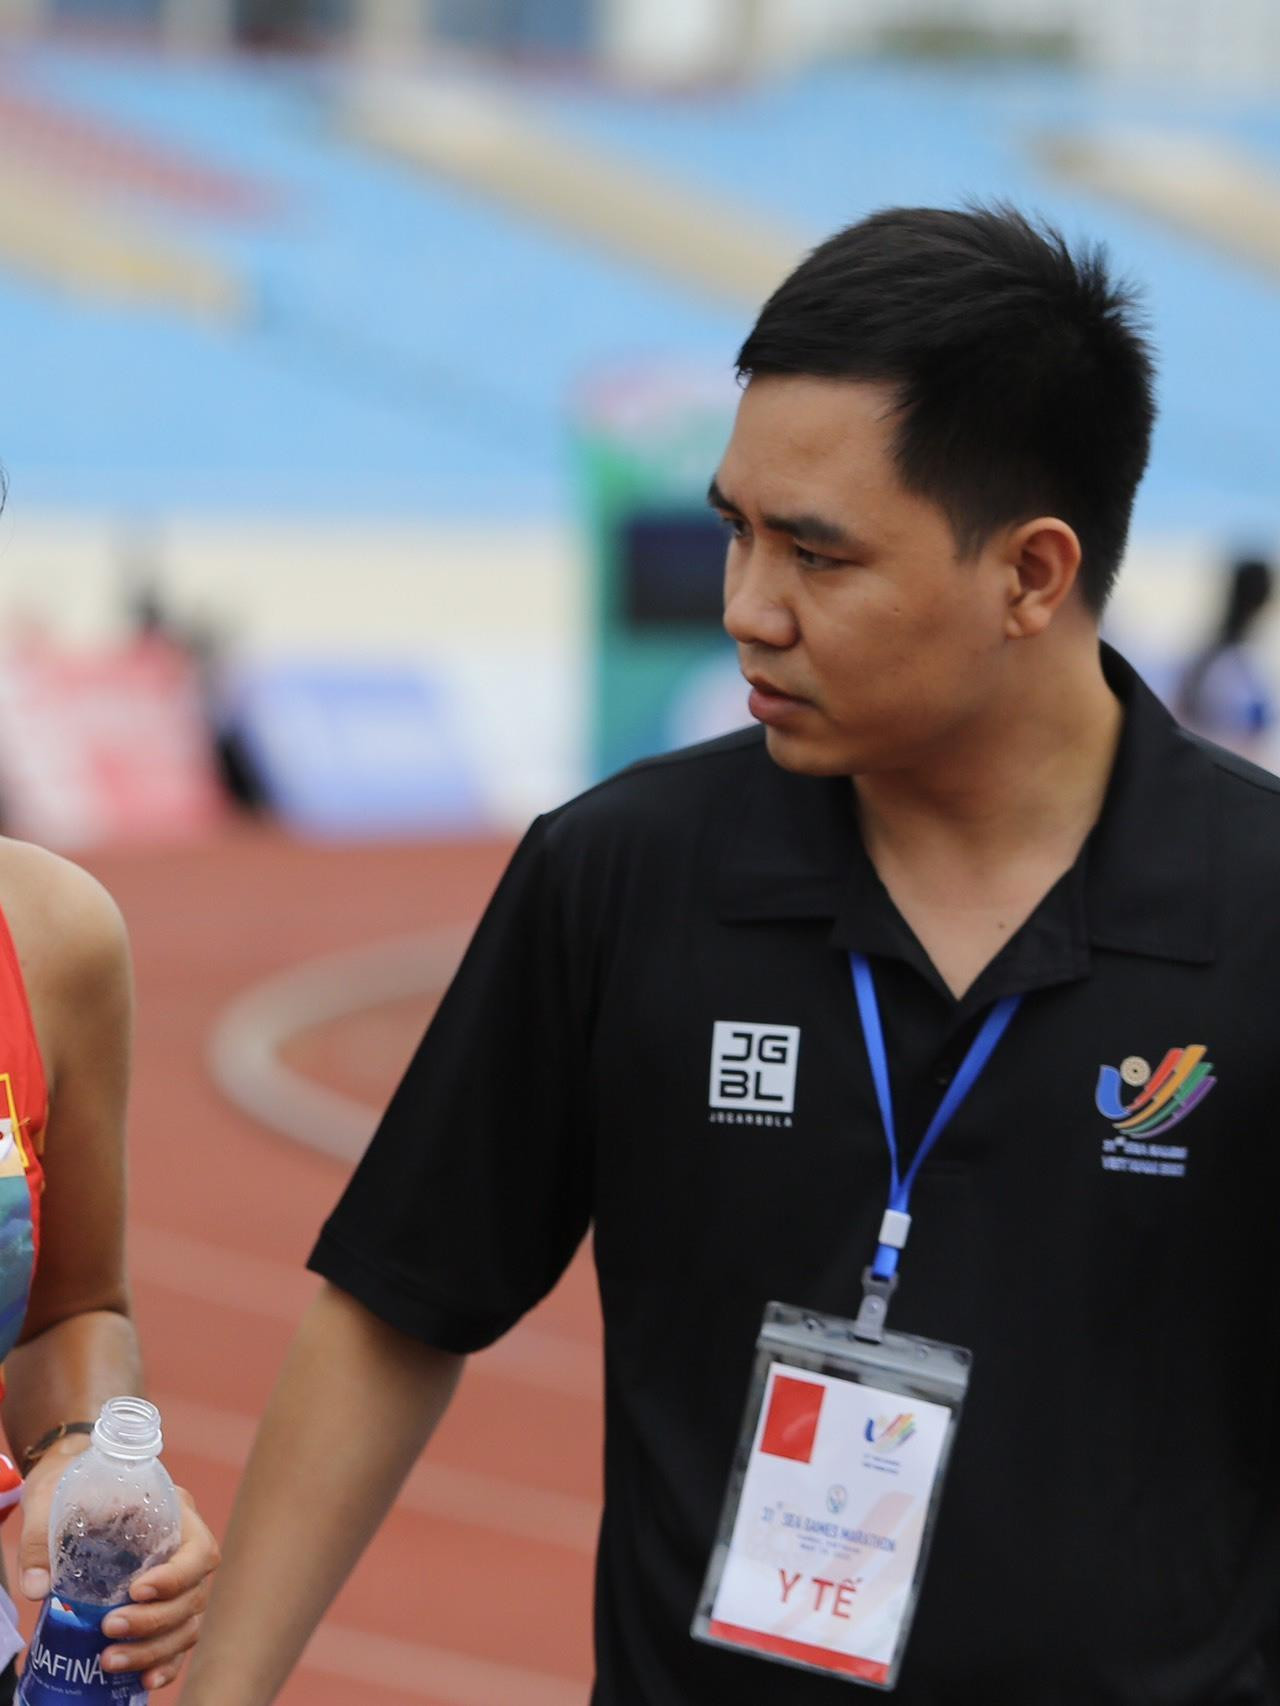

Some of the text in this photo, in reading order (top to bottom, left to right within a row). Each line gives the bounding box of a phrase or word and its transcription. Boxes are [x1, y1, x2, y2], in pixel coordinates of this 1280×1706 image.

[779, 1567, 863, 1620] Y TẾ
[31, 1643, 105, 1685] UAFINA
